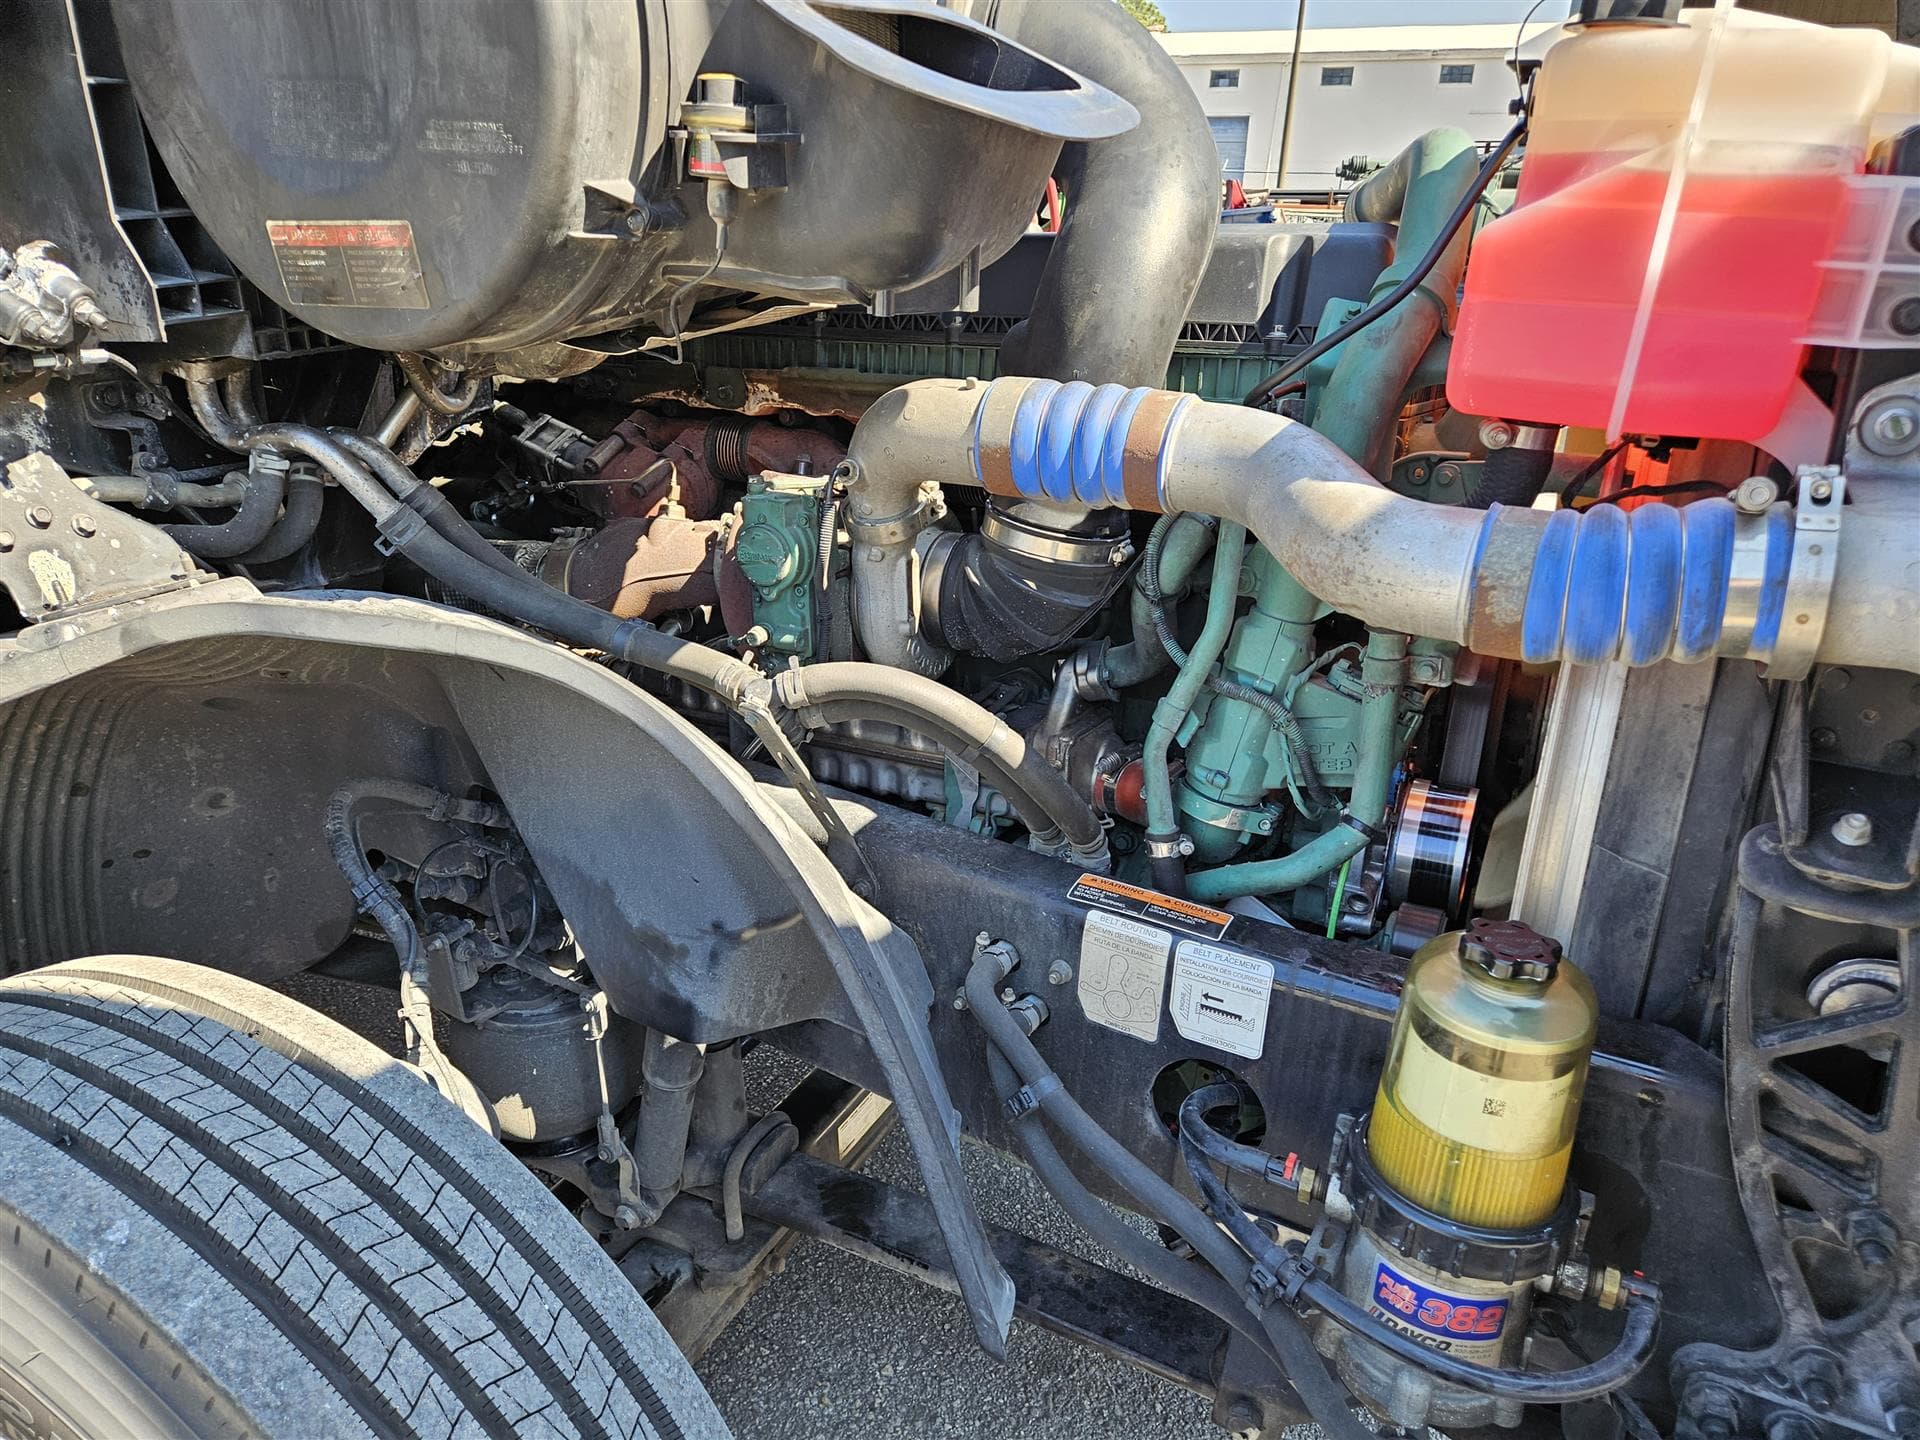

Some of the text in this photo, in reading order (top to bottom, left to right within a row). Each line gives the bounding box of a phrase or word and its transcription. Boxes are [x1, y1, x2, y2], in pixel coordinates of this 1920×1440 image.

[1099, 879, 1145, 896] WARNING
[1174, 900, 1220, 917] CUIDADO
[1088, 923, 1164, 953] CHEMIN DE COURROIES
[1100, 914, 1158, 939] BELT ROUTING
[1094, 936, 1154, 961] RUTA DE LA BANDA
[1193, 947, 1262, 972] BELT PLACEMENT
[1179, 956, 1219, 973] INSTALLATION
[1219, 967, 1232, 976] DES
[1222, 979, 1232, 988] DE
[1232, 982, 1241, 990] LA
[1240, 984, 1263, 997] BANDA
[1378, 1272, 1419, 1304] FUEL
[1378, 1287, 1417, 1315] PRO
[1418, 1298, 1505, 1334] 382
